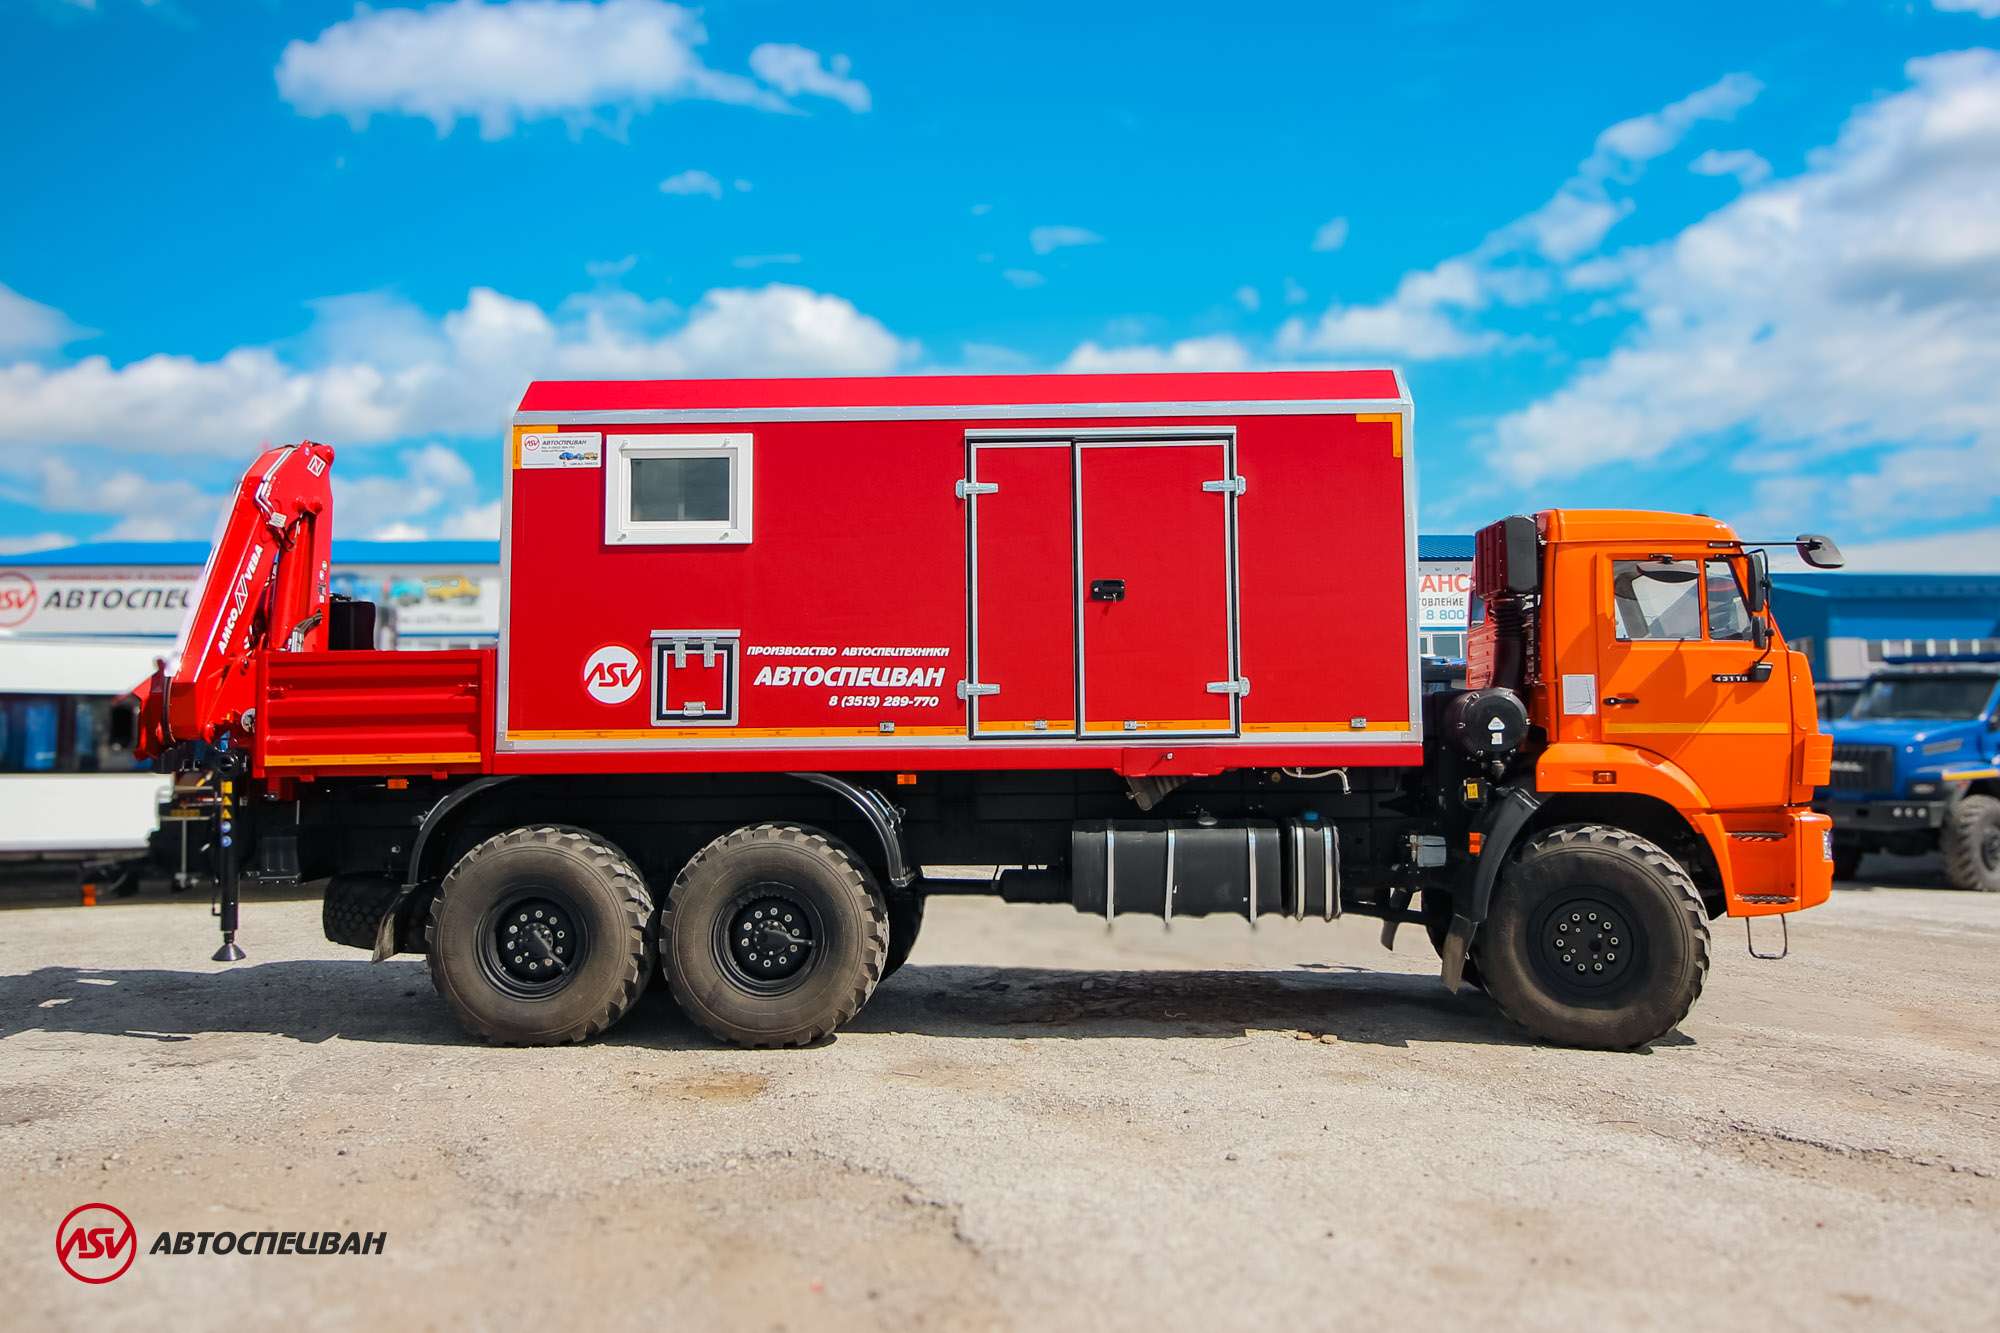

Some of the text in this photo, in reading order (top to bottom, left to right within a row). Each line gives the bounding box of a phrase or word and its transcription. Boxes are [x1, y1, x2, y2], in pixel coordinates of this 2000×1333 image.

[217, 544, 263, 655] AMCO VEBA
[1418, 597, 1464, 606] ОВЛЕНИЕ
[1426, 609, 1434, 620] 8
[746, 646, 950, 657] ПРОИЗВОДСТВО АВТОСПЕЦТЕХНИКИ
[584, 659, 641, 688] ASV
[753, 666, 946, 687] АВТОСПЕЦВАН
[828, 695, 940, 708] 8 (3513) 289-770
